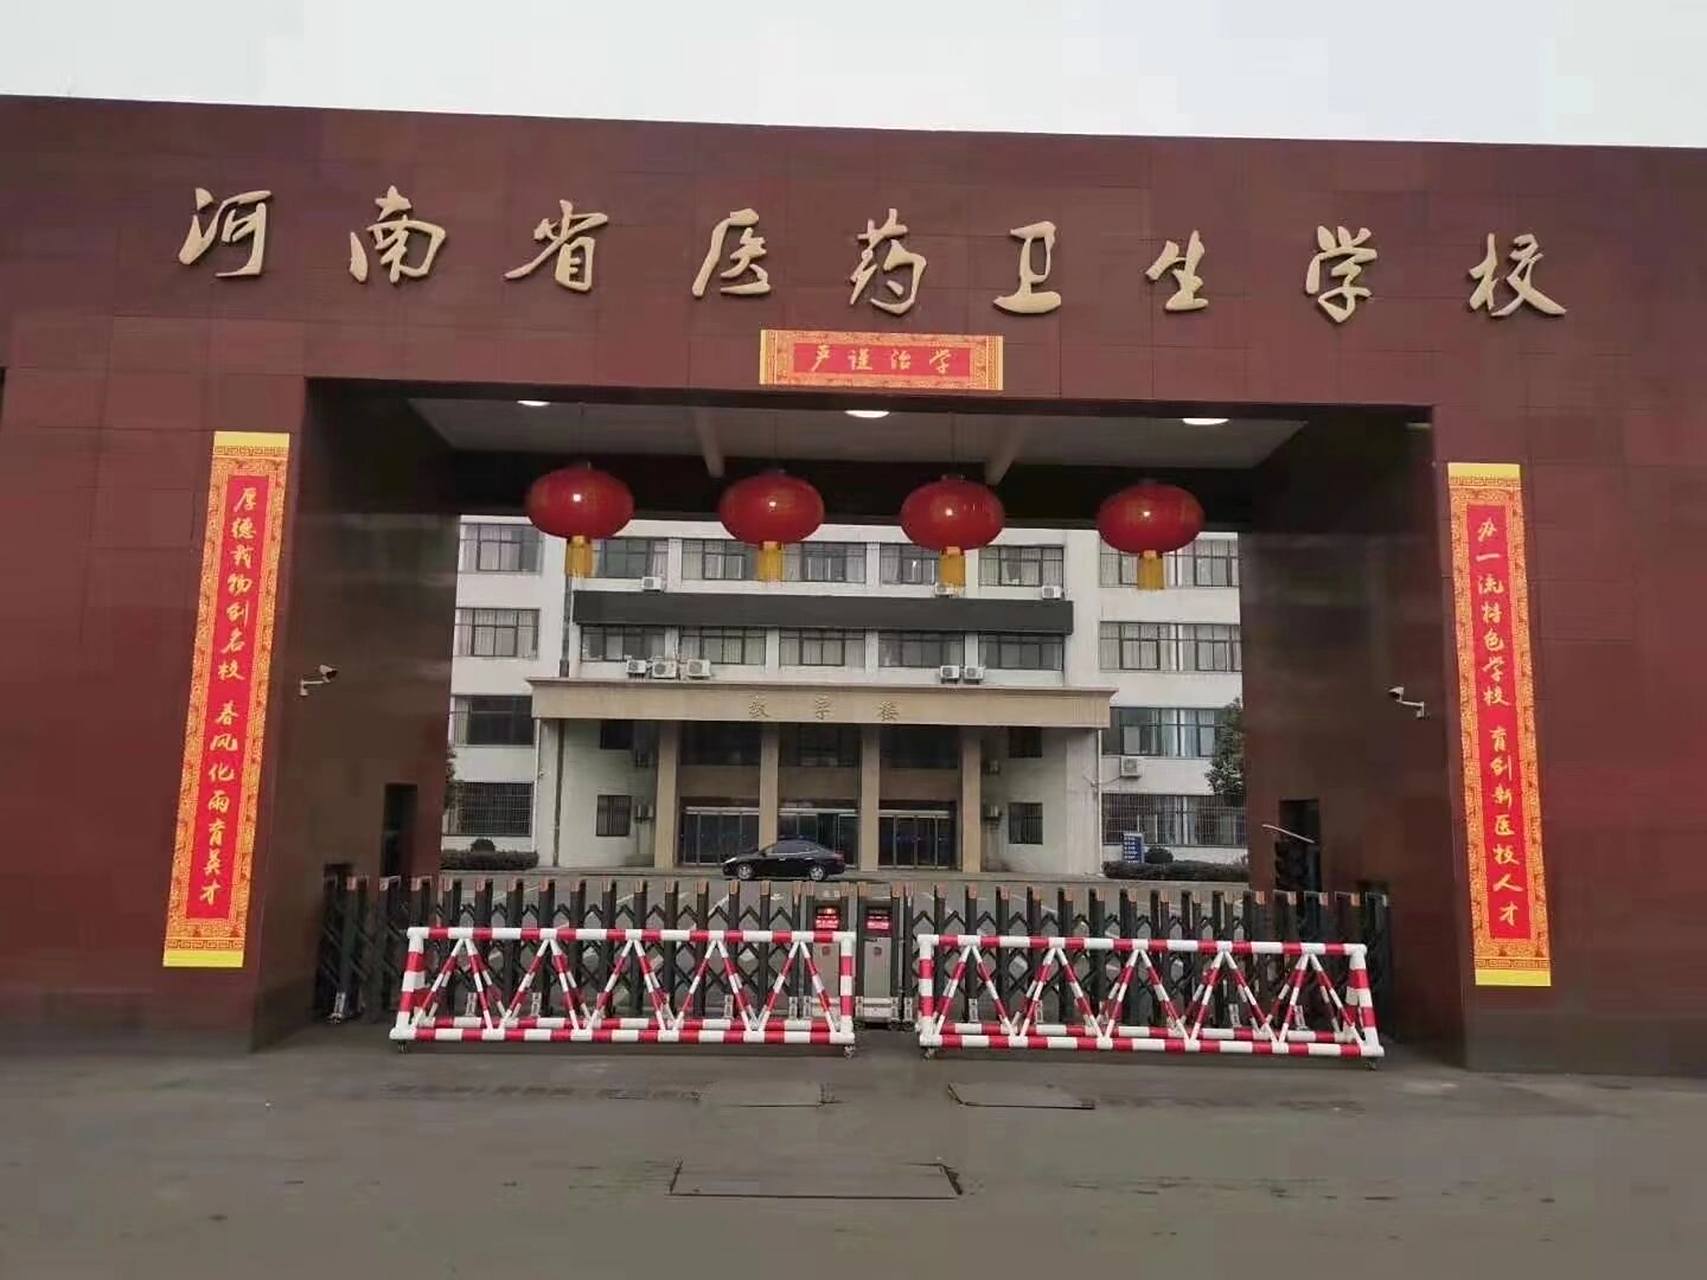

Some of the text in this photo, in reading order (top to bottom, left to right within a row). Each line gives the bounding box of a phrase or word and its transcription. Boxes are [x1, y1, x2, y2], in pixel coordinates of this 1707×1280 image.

[180, 186, 1566, 322] 河南省医药卫生学校
[810, 344, 953, 375] 严谨治学
[199, 700, 239, 906] 春风化雨育英才
[1475, 517, 1523, 926] 办一流特色学校 育创新医技人才
